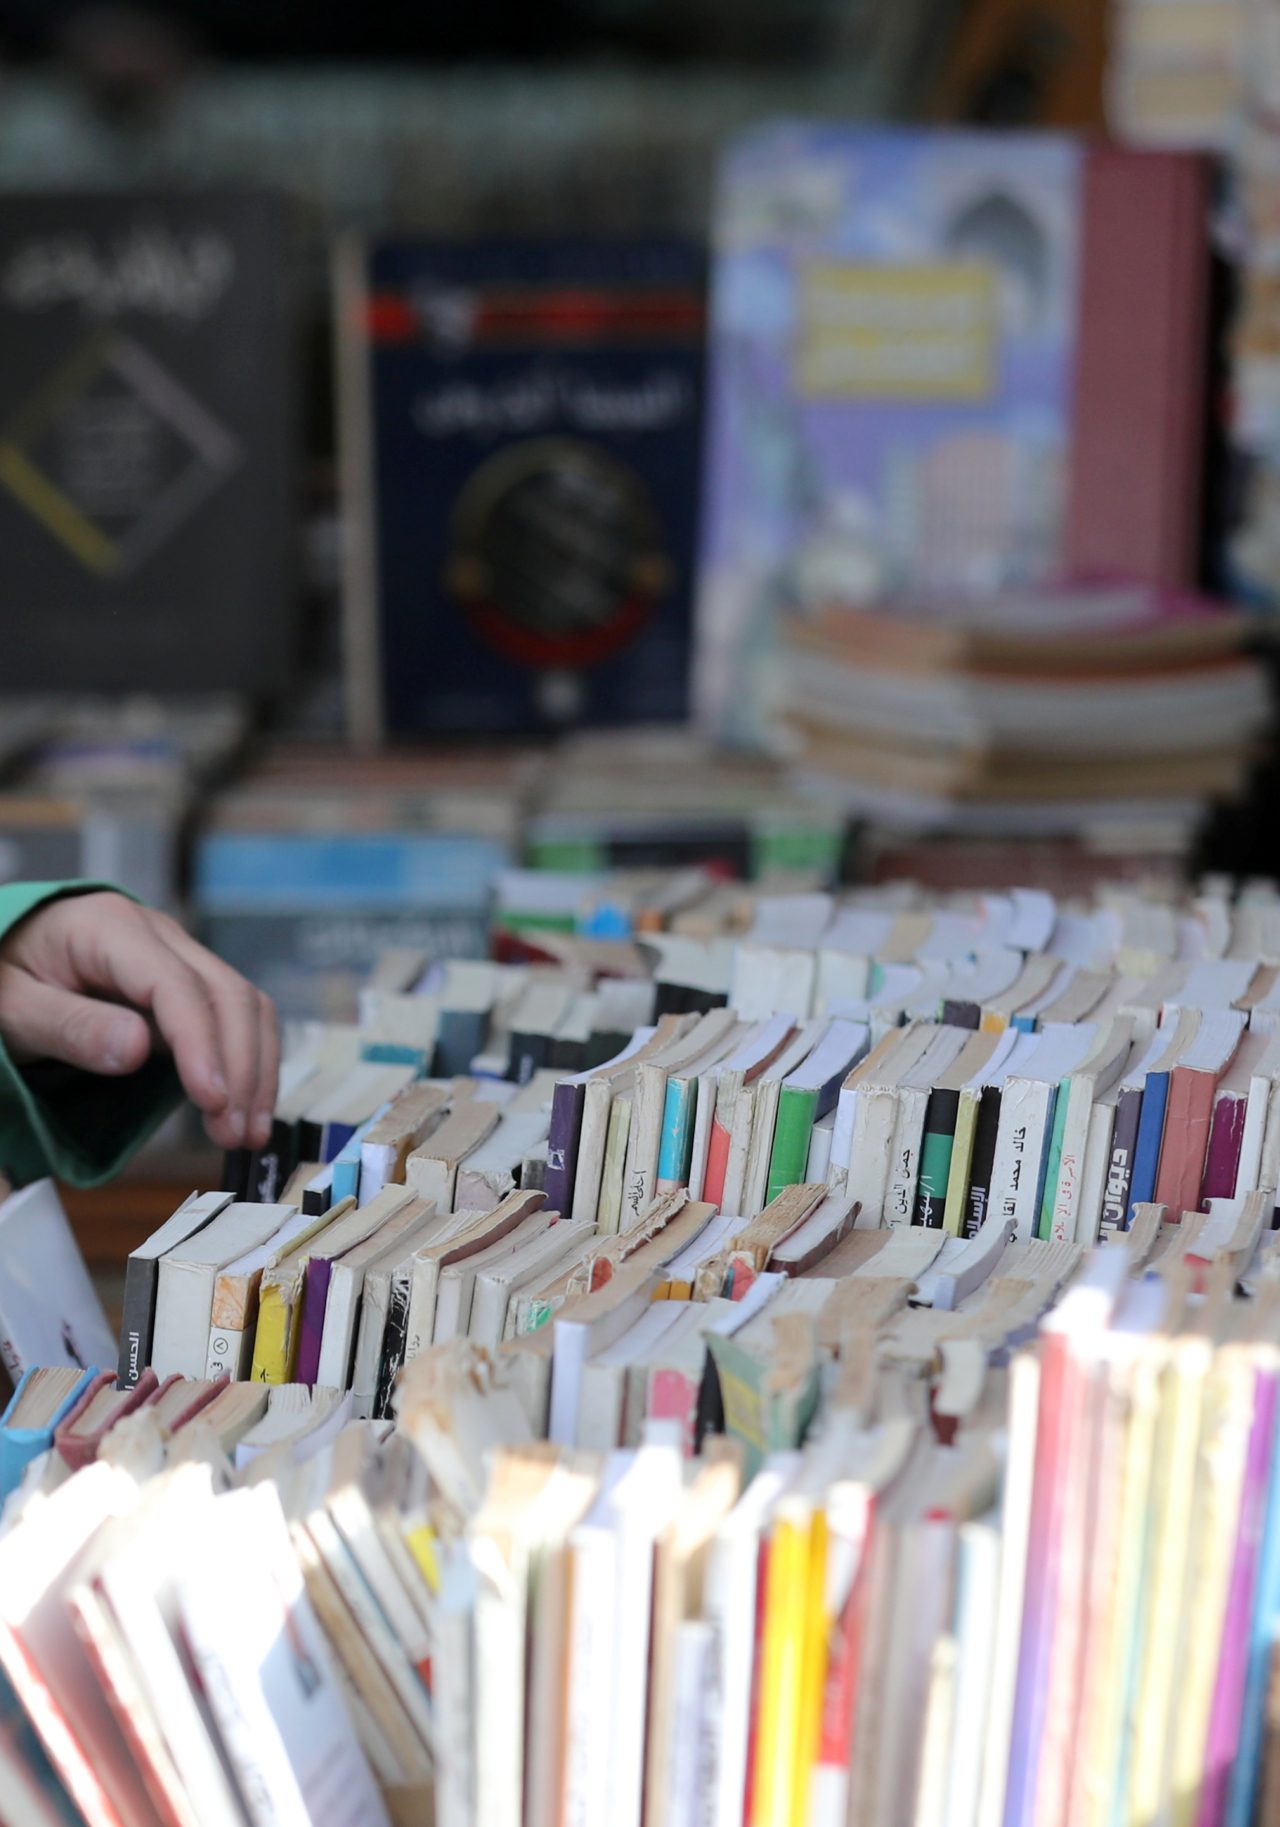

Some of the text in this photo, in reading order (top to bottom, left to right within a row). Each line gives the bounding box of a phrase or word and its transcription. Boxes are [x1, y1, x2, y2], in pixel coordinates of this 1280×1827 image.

[1012, 1126, 1026, 1153] خالد
[1009, 1159, 1022, 1191] محمد
[1102, 1148, 1130, 1221] ديوان
[1055, 1203, 1072, 1241] الإلام
[128, 1331, 140, 1381] الحسن
